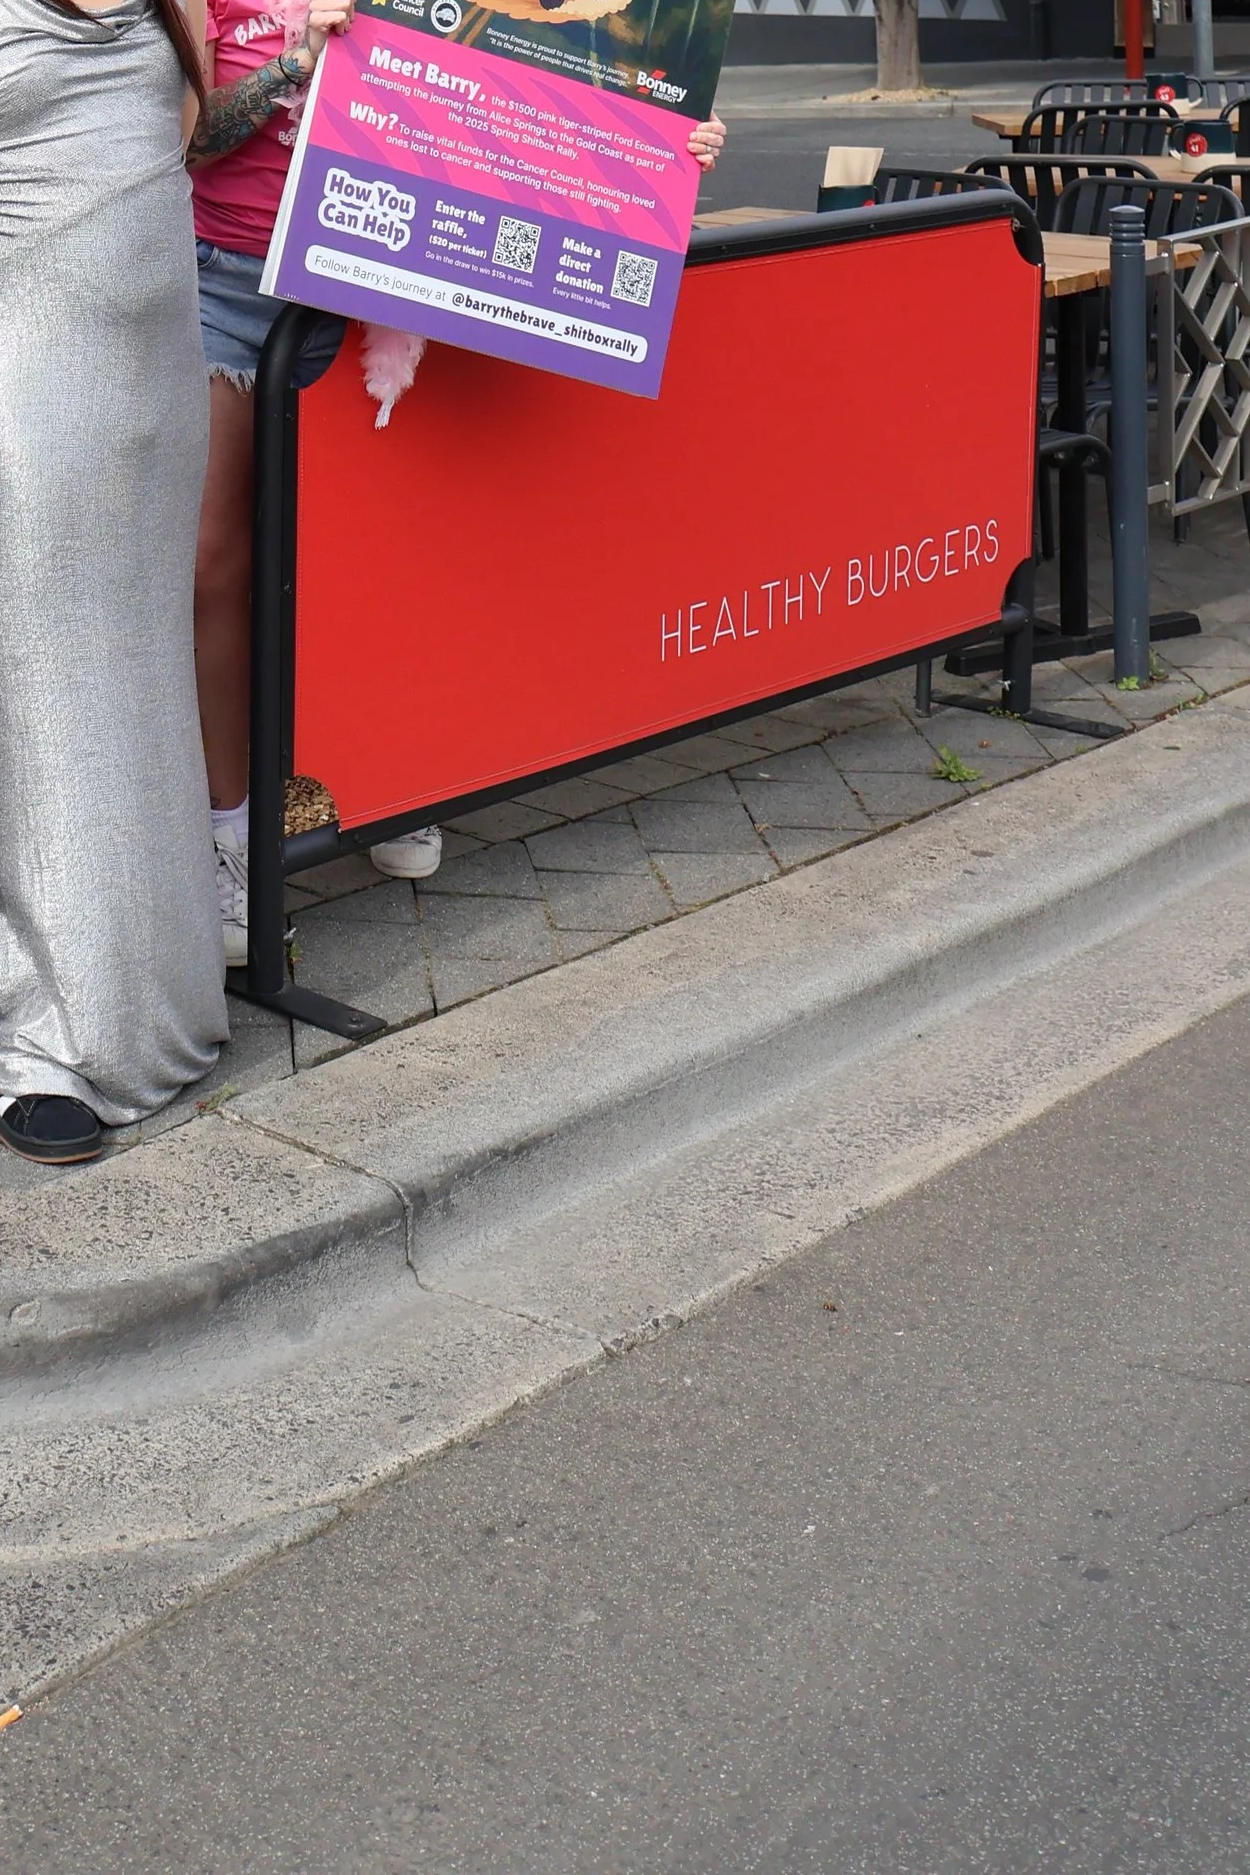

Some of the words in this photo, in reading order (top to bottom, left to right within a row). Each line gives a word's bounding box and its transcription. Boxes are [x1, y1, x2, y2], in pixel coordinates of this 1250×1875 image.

[392, 0, 424, 18] Council
[486, 27, 509, 41] Bonney
[510, 35, 531, 49] Energy
[537, 45, 556, 56] proud
[556, 49, 563, 57] to
[564, 52, 587, 66] support
[587, 59, 607, 71] Barry's
[503, 42, 514, 51] the
[514, 46, 534, 57] power
[534, 50, 541, 59] of
[541, 54, 562, 67] people
[562, 60, 574, 70] that
[574, 64, 594, 76] drives
[369, 46, 422, 80] Meet
[425, 63, 486, 101] Barry,
[491, 95, 506, 108] the
[508, 99, 536, 117] $1500
[538, 110, 557, 124] pink
[558, 116, 612, 141] tiger-striped
[614, 133, 633, 147] Ford
[635, 141, 675, 161] Econovan
[637, 70, 687, 102] Bonney
[652, 90, 677, 104] ENERGY
[360, 71, 411, 96] attempting
[413, 86, 428, 99] the
[429, 93, 465, 113] journey
[466, 104, 487, 118] from
[489, 111, 512, 125] Alice
[513, 118, 547, 137] Springs
[548, 130, 558, 139] to
[560, 131, 575, 144] the
[576, 137, 596, 152] Gold
[597, 145, 623, 160] Coast
[624, 154, 635, 162] as
[636, 156, 654, 170] part
[655, 162, 665, 173] of
[447, 111, 463, 125] the
[464, 116, 489, 132] 2025
[490, 123, 519, 143] Spring
[521, 133, 554, 152] Shitbox
[557, 144, 579, 160] Rally.
[350, 100, 399, 131] Why?
[399, 123, 411, 135] To
[411, 127, 435, 142] raise
[436, 133, 456, 148] vital
[457, 140, 484, 157] funds
[485, 149, 498, 161] for
[499, 153, 515, 167] the
[516, 159, 548, 177] Cancer
[550, 169, 585, 189] Council,
[587, 179, 630, 203] honouring
[632, 192, 655, 209] loved
[386, 134, 408, 148] ones
[410, 140, 428, 155] lost
[429, 147, 439, 158] to
[441, 151, 472, 168] cancer
[473, 158, 491, 174] and
[493, 166, 542, 191] supporting
[543, 179, 568, 197] those
[570, 187, 585, 201] still
[587, 192, 622, 213] fighting.
[329, 174, 372, 202] How
[377, 187, 411, 215] You
[323, 203, 358, 229] Can
[362, 214, 405, 246] Help
[432, 218, 468, 239] raffle,
[435, 200, 467, 218] Enter
[467, 210, 486, 225] the
[429, 234, 448, 247] ($20
[448, 241, 462, 252] per
[462, 245, 487, 259] ticket)
[559, 254, 592, 273] direct
[562, 237, 592, 257] Make
[593, 249, 602, 259] a
[425, 251, 435, 259] Go
[435, 253, 442, 261] in
[443, 255, 454, 264] the
[454, 258, 471, 269] draw
[471, 263, 479, 271] to
[479, 266, 491, 275] win
[491, 269, 506, 280] $15k
[507, 273, 513, 281] in
[513, 276, 535, 288] prizes.
[555, 270, 604, 294] donation
[314, 254, 350, 275] Follow
[352, 266, 390, 286] Barry's
[391, 278, 433, 300] journey
[435, 290, 447, 302] at
[451, 292, 638, 357] @barrythebrave_shitboxrally
[552, 287, 570, 299] Every
[571, 291, 584, 302] little
[585, 295, 593, 304] bit
[593, 299, 612, 310] helps.
[662, 566, 832, 662] HEALTHY
[847, 519, 1000, 606] BURGERS
